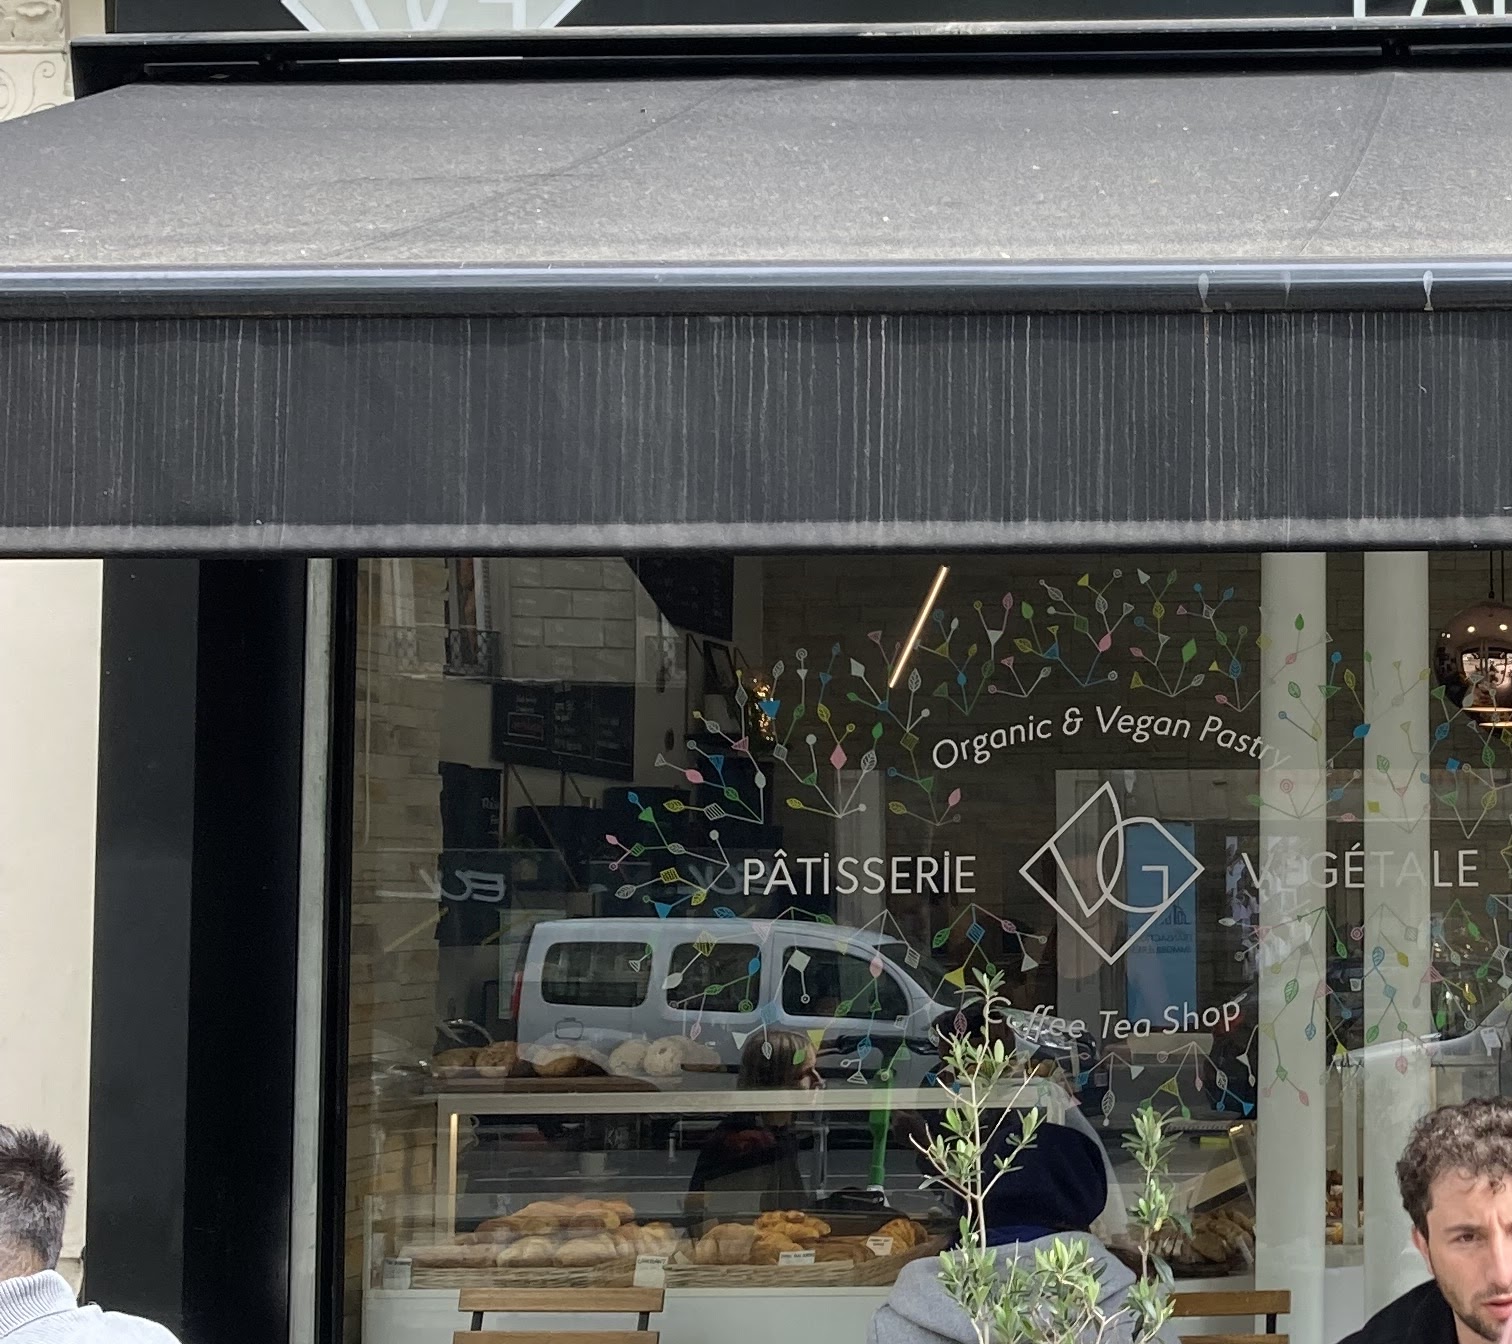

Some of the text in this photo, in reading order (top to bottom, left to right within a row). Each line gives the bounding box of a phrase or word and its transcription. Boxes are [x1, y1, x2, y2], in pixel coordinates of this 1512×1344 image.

[931, 705, 1292, 773] Organic & Vegan Pastry
[743, 848, 977, 896] PÂTISSERIE
[982, 996, 1242, 1042] Coffee Tea Shop
